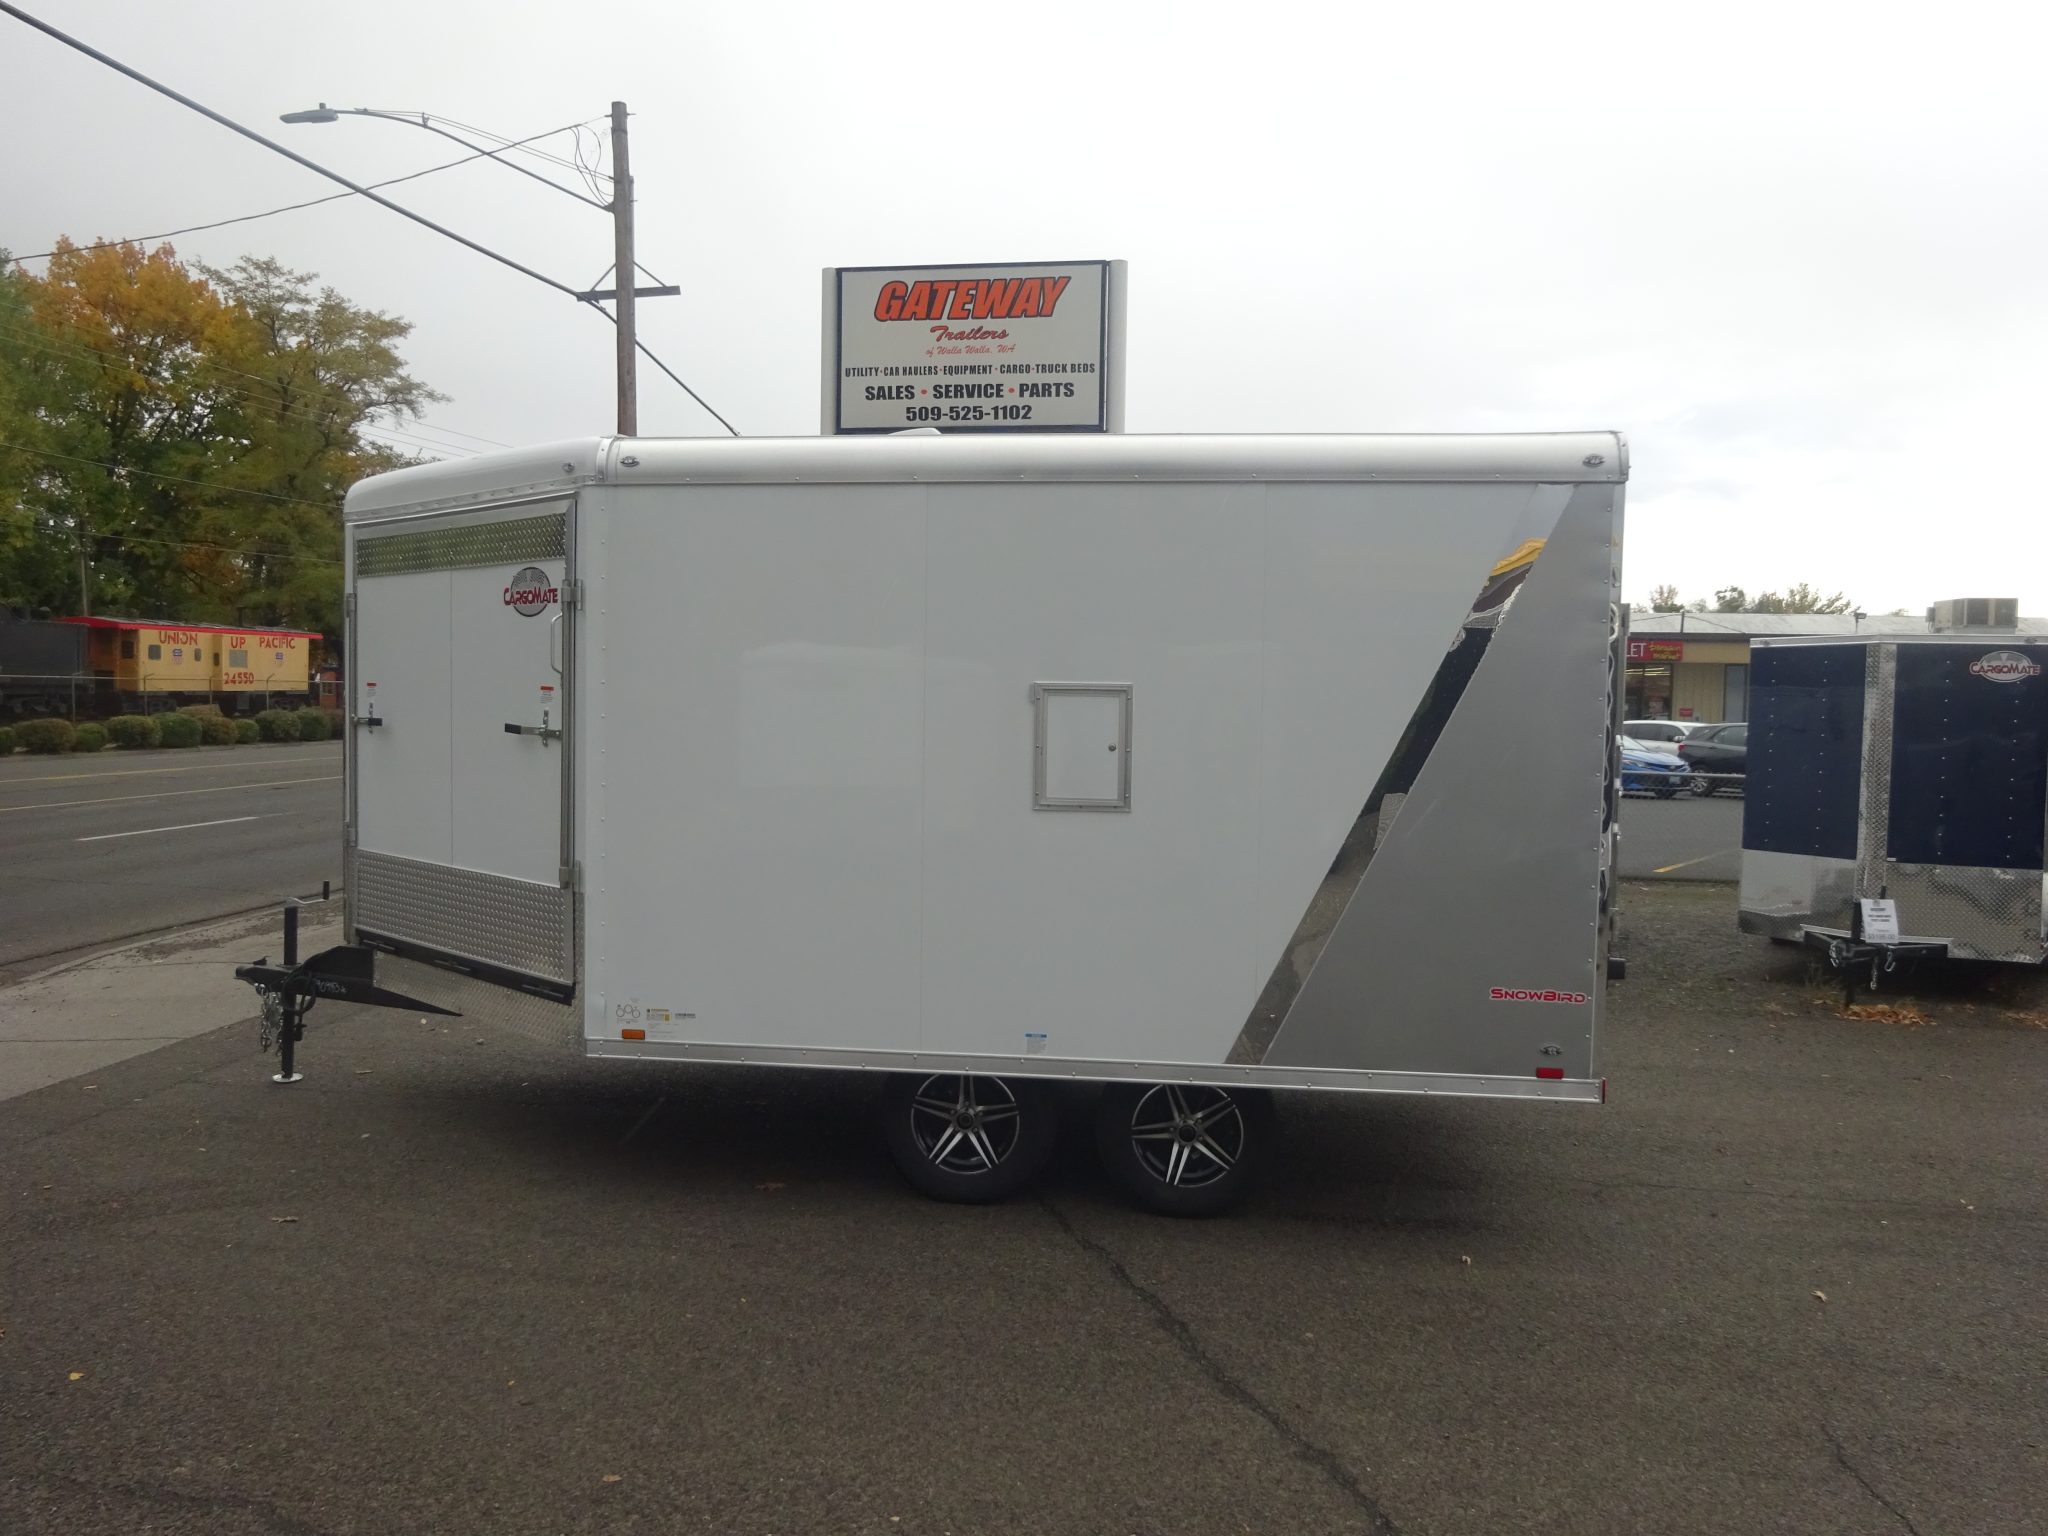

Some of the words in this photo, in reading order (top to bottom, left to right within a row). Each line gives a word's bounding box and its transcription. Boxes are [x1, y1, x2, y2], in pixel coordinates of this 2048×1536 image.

[874, 276, 1071, 322] GATEWAY
[930, 325, 1009, 342] Trailers
[925, 346, 935, 358] of
[937, 346, 962, 355] Walla
[997, 343, 1016, 354] WA
[845, 367, 880, 378] UTILITY
[883, 366, 900, 377] CAR
[902, 365, 939, 377] HAULERS
[943, 364, 993, 376] EQUIPMENT
[1000, 363, 1031, 374] CARGO
[1035, 363, 1068, 374] TRUCK
[1070, 363, 1096, 374] BEDS
[865, 385, 915, 400] SALES
[932, 383, 1004, 399] SERVICE
[1018, 382, 1075, 398] PARTS
[905, 404, 1033, 422] 509-525-1102
[158, 631, 199, 646] UNION
[230, 636, 247, 649] UP
[259, 637, 296, 650] PACIFIC
[223, 672, 255, 685] 24550
